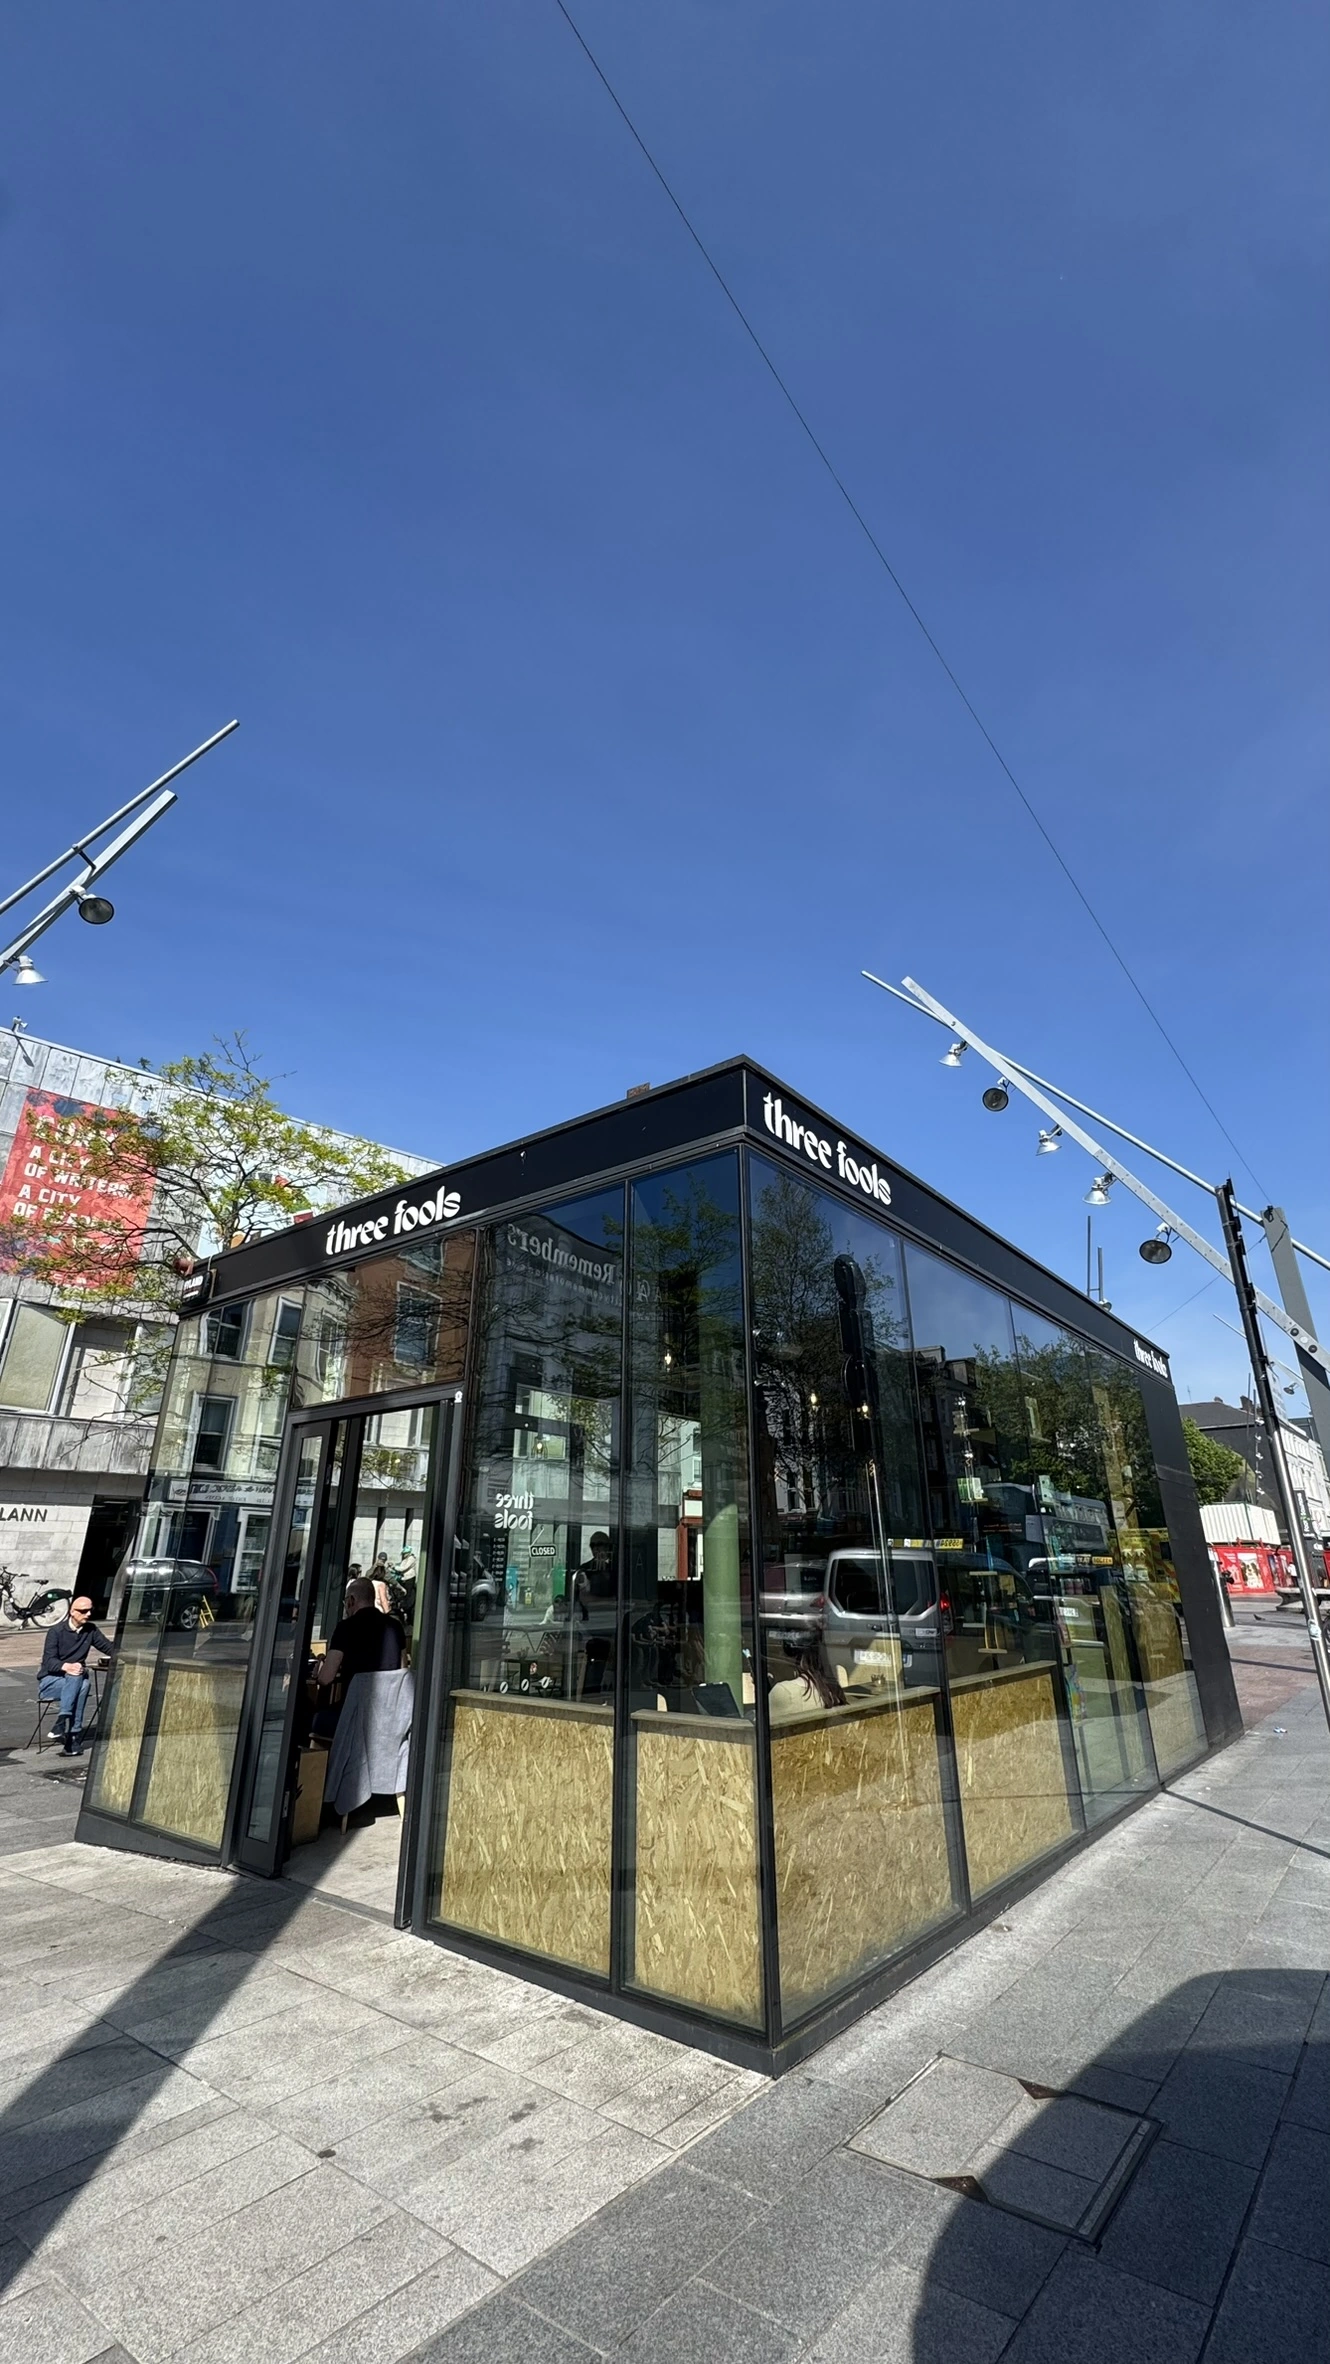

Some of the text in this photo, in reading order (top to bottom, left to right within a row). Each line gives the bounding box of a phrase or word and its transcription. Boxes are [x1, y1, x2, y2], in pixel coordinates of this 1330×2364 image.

[29, 1145, 42, 1160] A
[763, 1092, 892, 1205] three fools
[24, 1163, 48, 1180] OF
[18, 1184, 81, 1207] A CITY
[13, 1202, 38, 1218] OF
[325, 1185, 461, 1255] three fools
[0, 1507, 47, 1522] LANN
[531, 1547, 555, 1555] CLOSED
